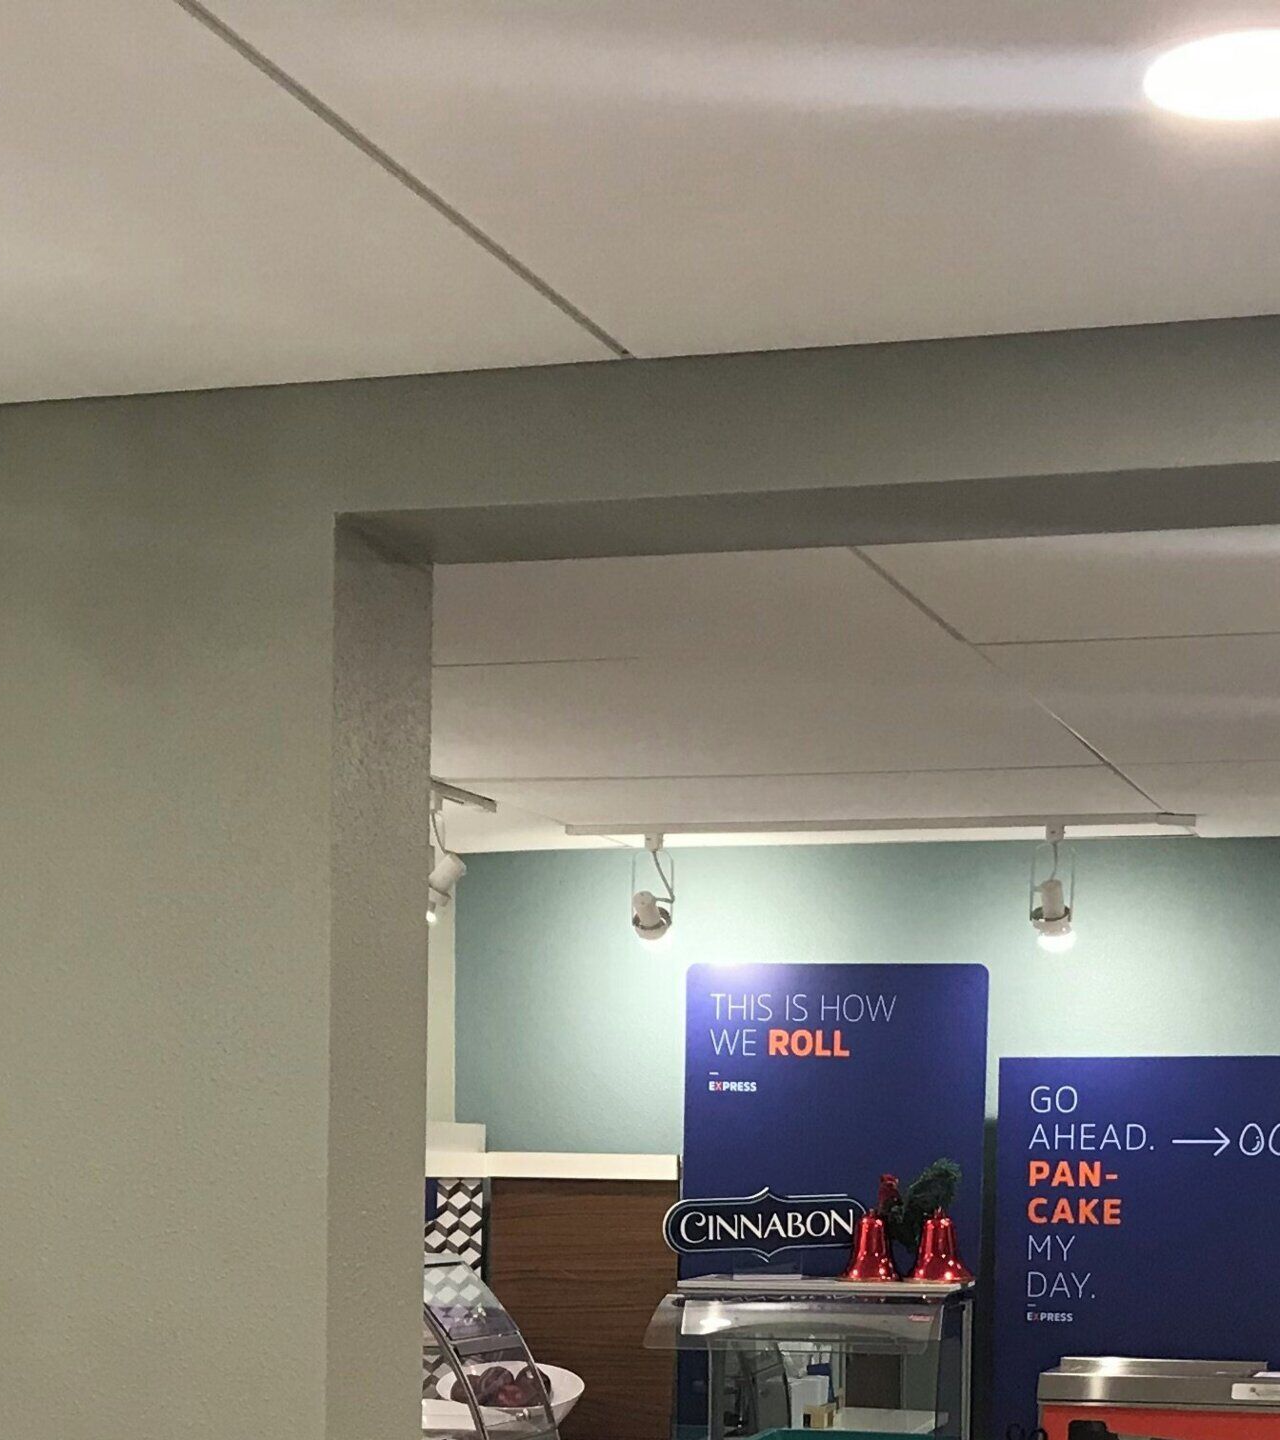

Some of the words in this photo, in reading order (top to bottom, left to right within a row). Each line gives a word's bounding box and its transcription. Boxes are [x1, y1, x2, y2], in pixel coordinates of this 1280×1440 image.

[709, 993, 773, 1022] THIS
[785, 993, 809, 1022] IS
[820, 993, 898, 1023] HOW
[709, 1028, 758, 1057] WE
[768, 1029, 851, 1058] ROLL
[708, 1080, 758, 1093] EXPRESS
[1030, 1085, 1078, 1114] GO
[1028, 1123, 1155, 1151] AHEAD.
[1028, 1160, 1119, 1187] PAN-
[1027, 1197, 1122, 1225] CAKE
[679, 1208, 856, 1245] CINNABON
[1027, 1234, 1076, 1261] MY
[1027, 1271, 1096, 1299] DAY.
[1026, 1312, 1074, 1322] EXPRESS
